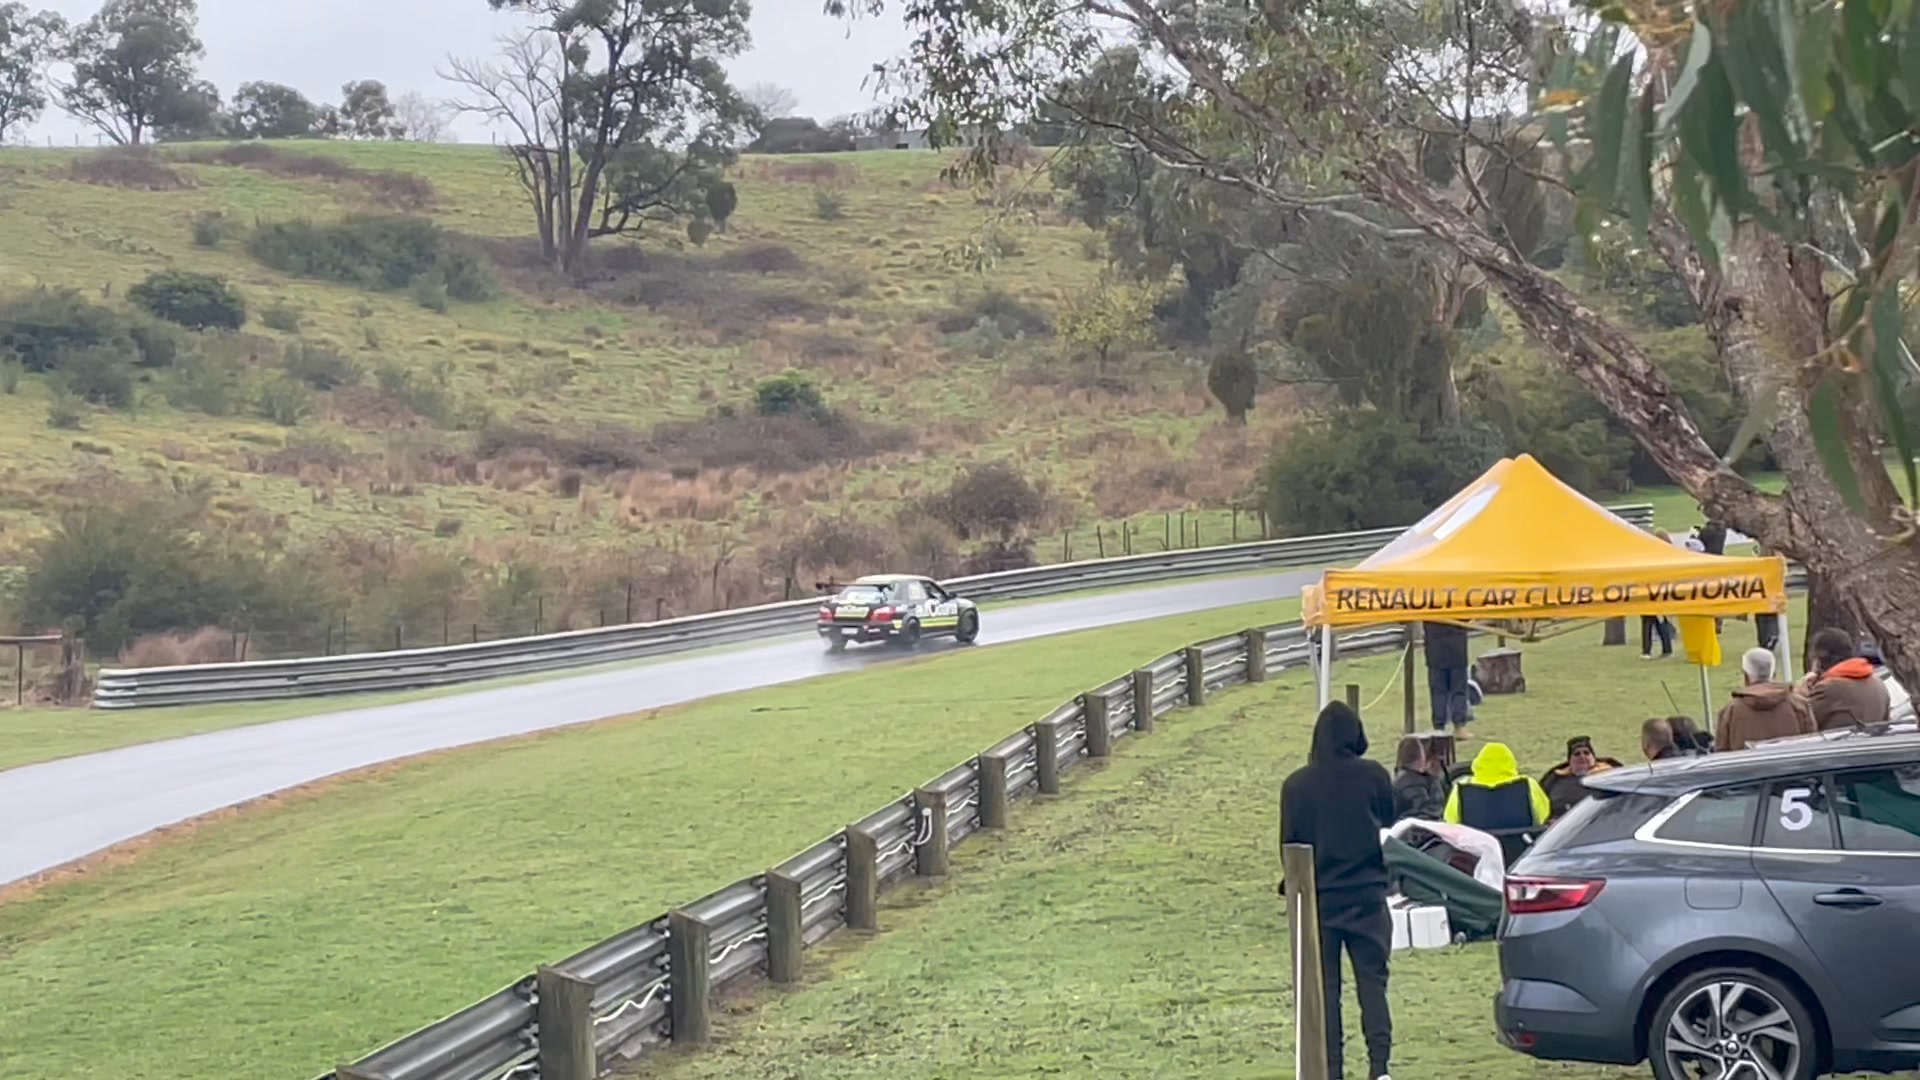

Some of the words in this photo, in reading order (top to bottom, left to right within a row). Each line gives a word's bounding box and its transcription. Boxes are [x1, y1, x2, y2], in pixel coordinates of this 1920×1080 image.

[1336, 586, 1458, 610] RENAULT
[1465, 587, 1517, 608] CAR
[1524, 585, 1594, 606] CLUB
[1602, 583, 1639, 603] OF
[1646, 576, 1767, 601] VICTORIA
[1780, 788, 1813, 831] 5
